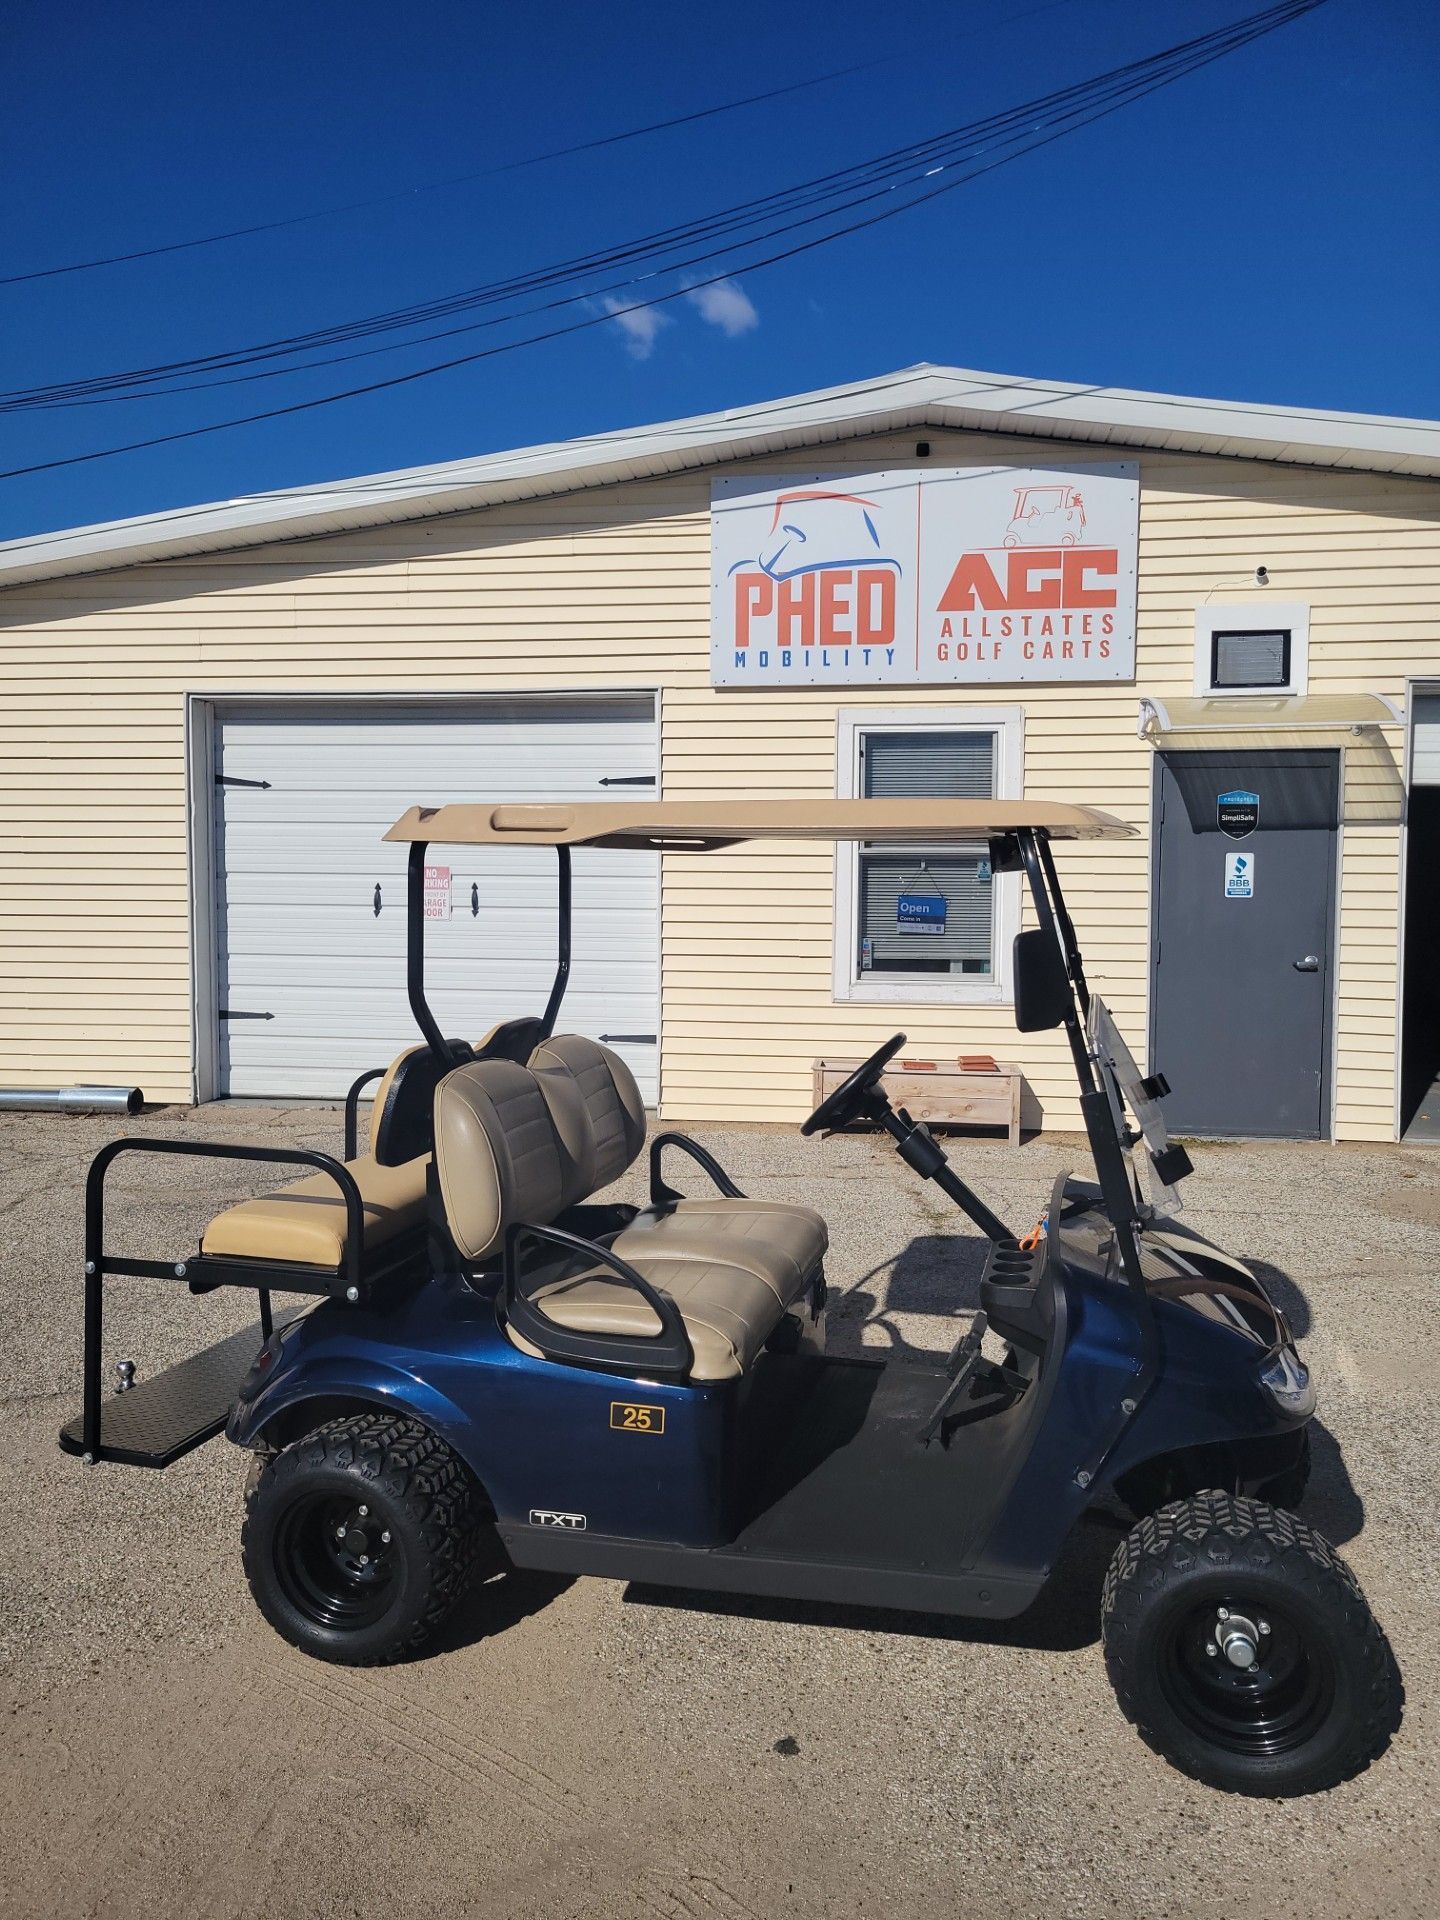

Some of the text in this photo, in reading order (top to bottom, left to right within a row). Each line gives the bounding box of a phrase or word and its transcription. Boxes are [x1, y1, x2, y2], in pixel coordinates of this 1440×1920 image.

[936, 549, 1118, 612] AGC
[735, 569, 896, 647] PHED
[940, 613, 1114, 638] ALLSTATES
[735, 648, 895, 668] MOBILITY
[937, 639, 1111, 661] GOLF CARTS
[1221, 814, 1255, 822] SimpliSafe
[426, 868, 437, 878] NO
[900, 902, 930, 914] Open
[623, 1407, 651, 1429] 25
[534, 1512, 582, 1527] TXT
